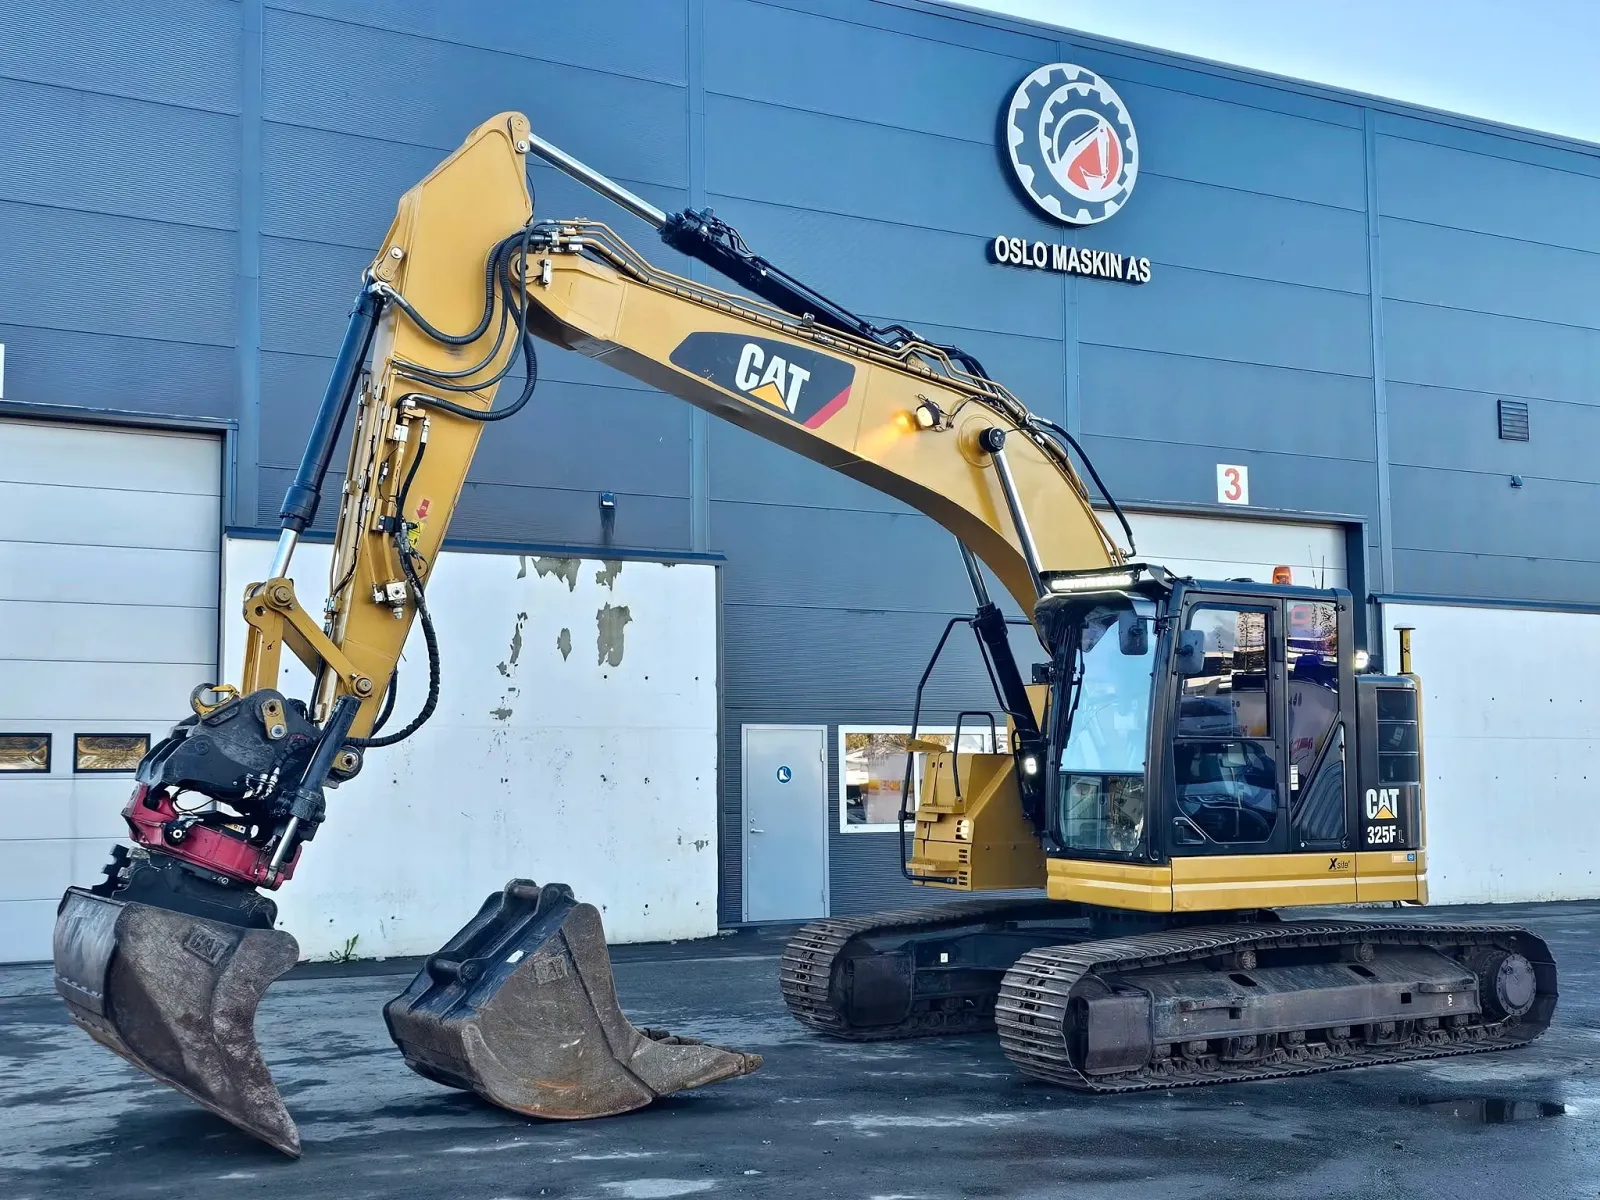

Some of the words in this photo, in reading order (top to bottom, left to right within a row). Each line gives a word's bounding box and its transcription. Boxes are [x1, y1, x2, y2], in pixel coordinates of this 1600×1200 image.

[994, 235, 1048, 268] OSLO
[1052, 244, 1122, 279] MASKIN
[1126, 255, 1151, 283] AS
[735, 343, 811, 415] CAT
[1224, 468, 1242, 501] 3
[1366, 788, 1400, 819] CAT
[1367, 825, 1396, 844] 325F
